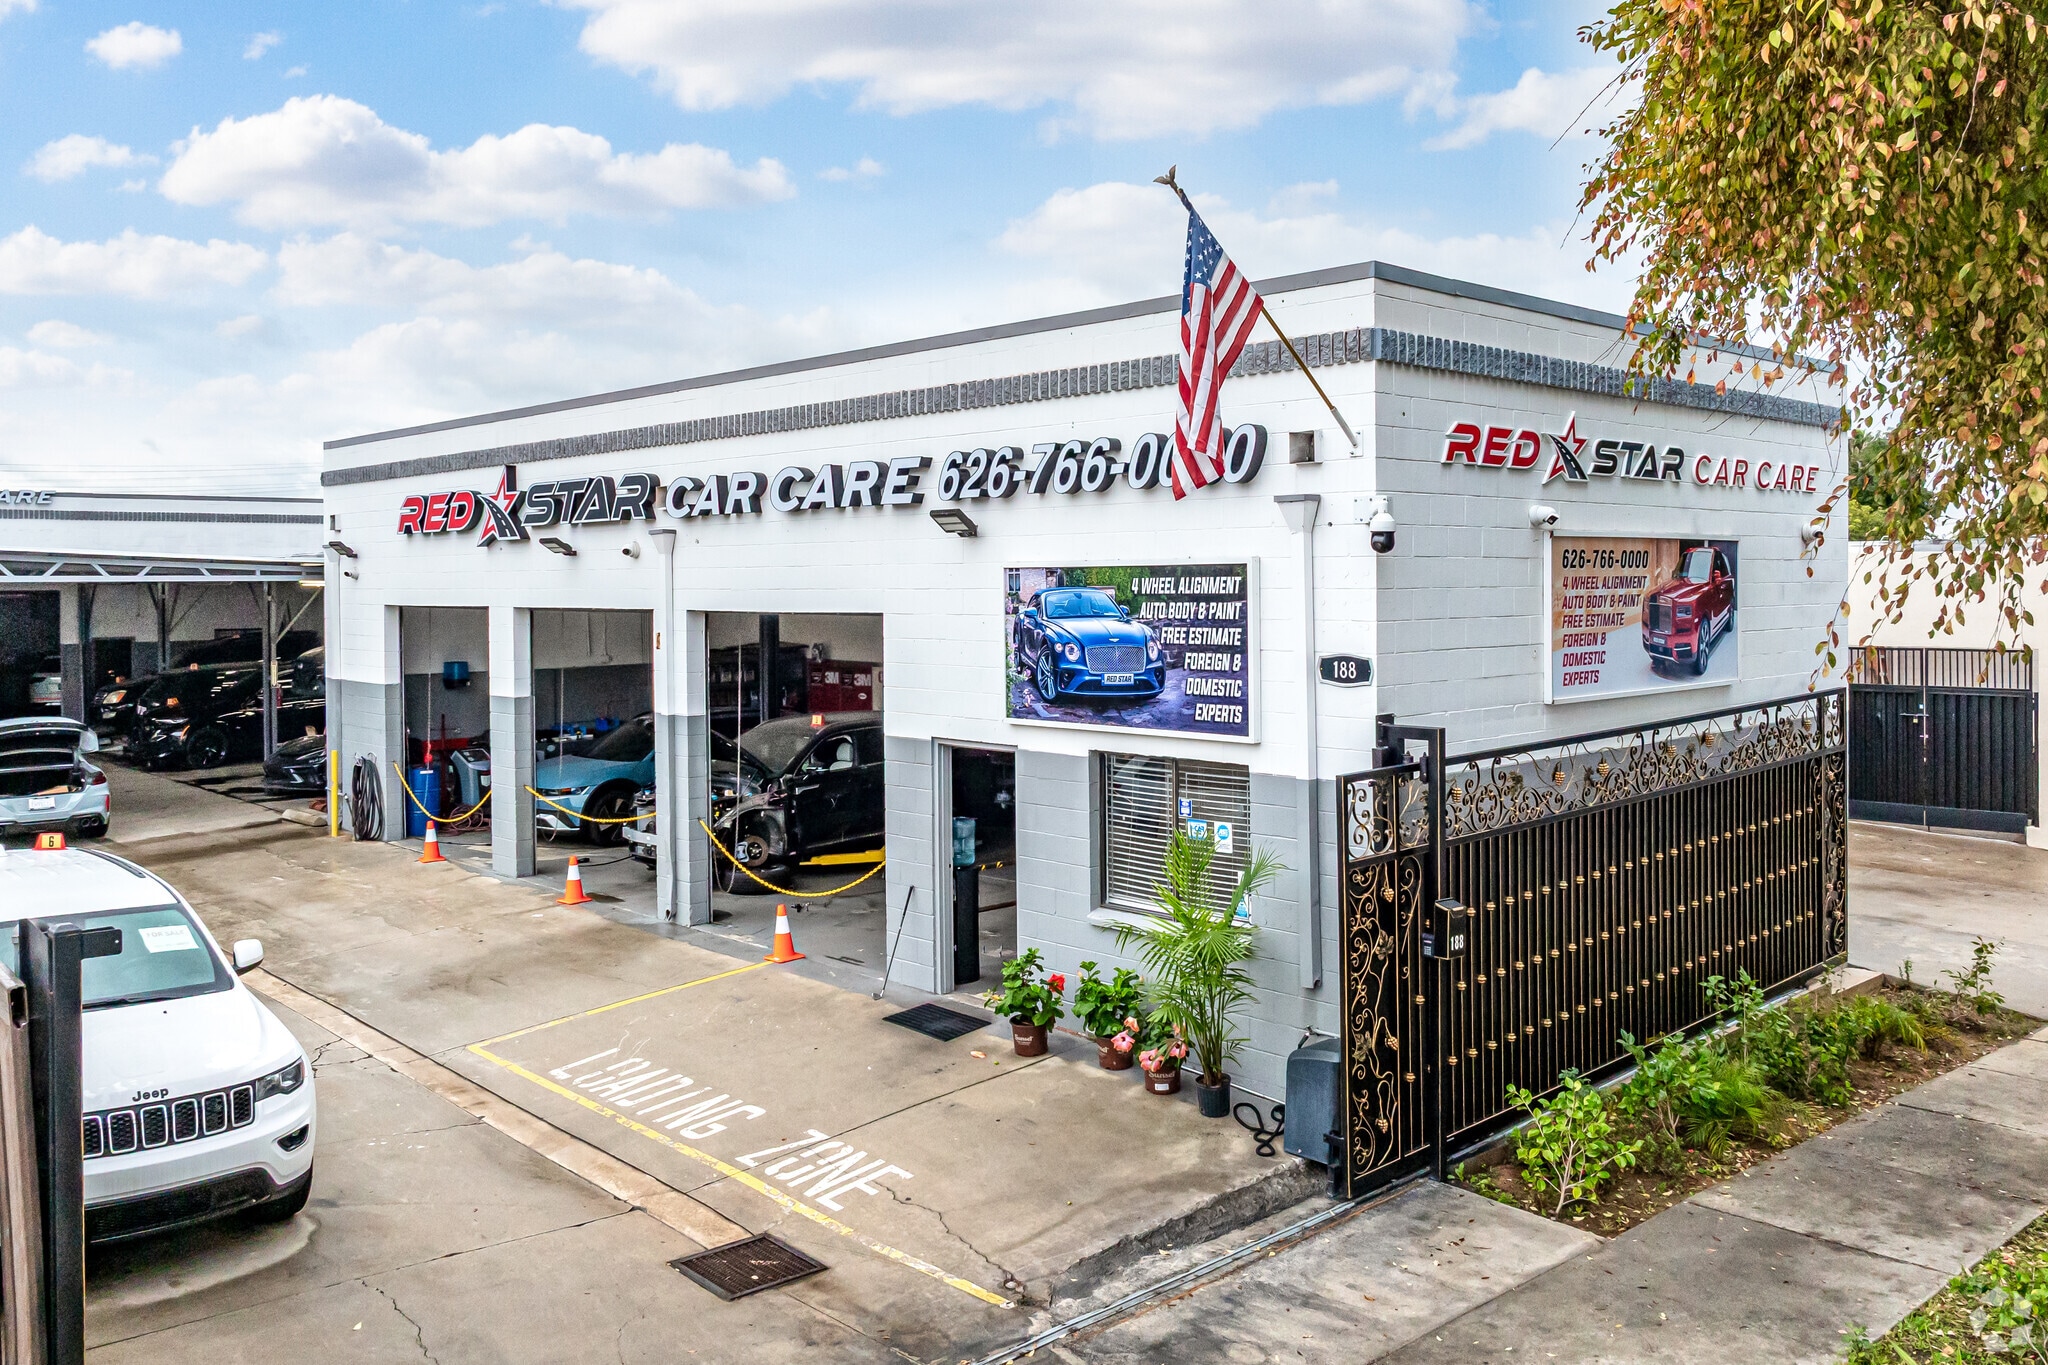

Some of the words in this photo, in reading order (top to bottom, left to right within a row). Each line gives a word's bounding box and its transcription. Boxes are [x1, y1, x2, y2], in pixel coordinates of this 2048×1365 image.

[1441, 421, 1541, 470] RED
[1588, 438, 1686, 482] STAR
[1692, 454, 1749, 488] CAR
[1754, 460, 1820, 494] CARE
[397, 490, 482, 534] RED
[522, 473, 660, 527] STAR
[666, 471, 768, 519] CAR
[770, 456, 933, 514] CARE
[938, 424, 1267, 501] 626-766-00
[1562, 549, 1649, 569] 626-766-0000
[1131, 577, 1139, 594] 4
[1141, 577, 1176, 594] WHEEL
[1178, 576, 1242, 594] ALIGNMENT
[1562, 576, 1569, 590] 4
[1571, 576, 1600, 590] WHEEL
[1601, 576, 1648, 590] ALIGNMENT
[1562, 595, 1584, 609] AUTO
[1586, 594, 1608, 608] BODY
[1609, 594, 1616, 607] &
[1617, 593, 1641, 607] PAINT
[1139, 602, 1167, 619] AUTO
[1167, 602, 1197, 619] BODY
[1197, 602, 1206, 619] &
[1208, 602, 1242, 620] PAINT
[1562, 614, 1584, 629] FREE
[1585, 613, 1625, 628] ESTIMATE
[1160, 627, 1187, 644] FREE
[1188, 627, 1242, 646] ESTIMATE
[1562, 633, 1599, 648] FOREIGN
[1600, 632, 1607, 646] &
[1184, 652, 1231, 671] FOREIGN
[1232, 653, 1241, 671] &
[1562, 651, 1606, 667] DOMESTIC
[1333, 660, 1357, 679] 188
[824, 671, 840, 685] 3M
[853, 673, 872, 687] 3M
[1106, 675, 1117, 683] RED
[1118, 675, 1132, 683] STAR
[1562, 670, 1600, 686] EXPERTS
[1186, 678, 1242, 697] DOMESTIC
[1195, 703, 1243, 723] EXPERTS
[48, 835, 55, 848] 6
[165, 929, 185, 938] SALE
[1450, 934, 1464, 951] 188
[132, 1088, 169, 1102] Jeep
[548, 1047, 766, 1140] LOADING
[735, 1129, 915, 1212] ZONE
